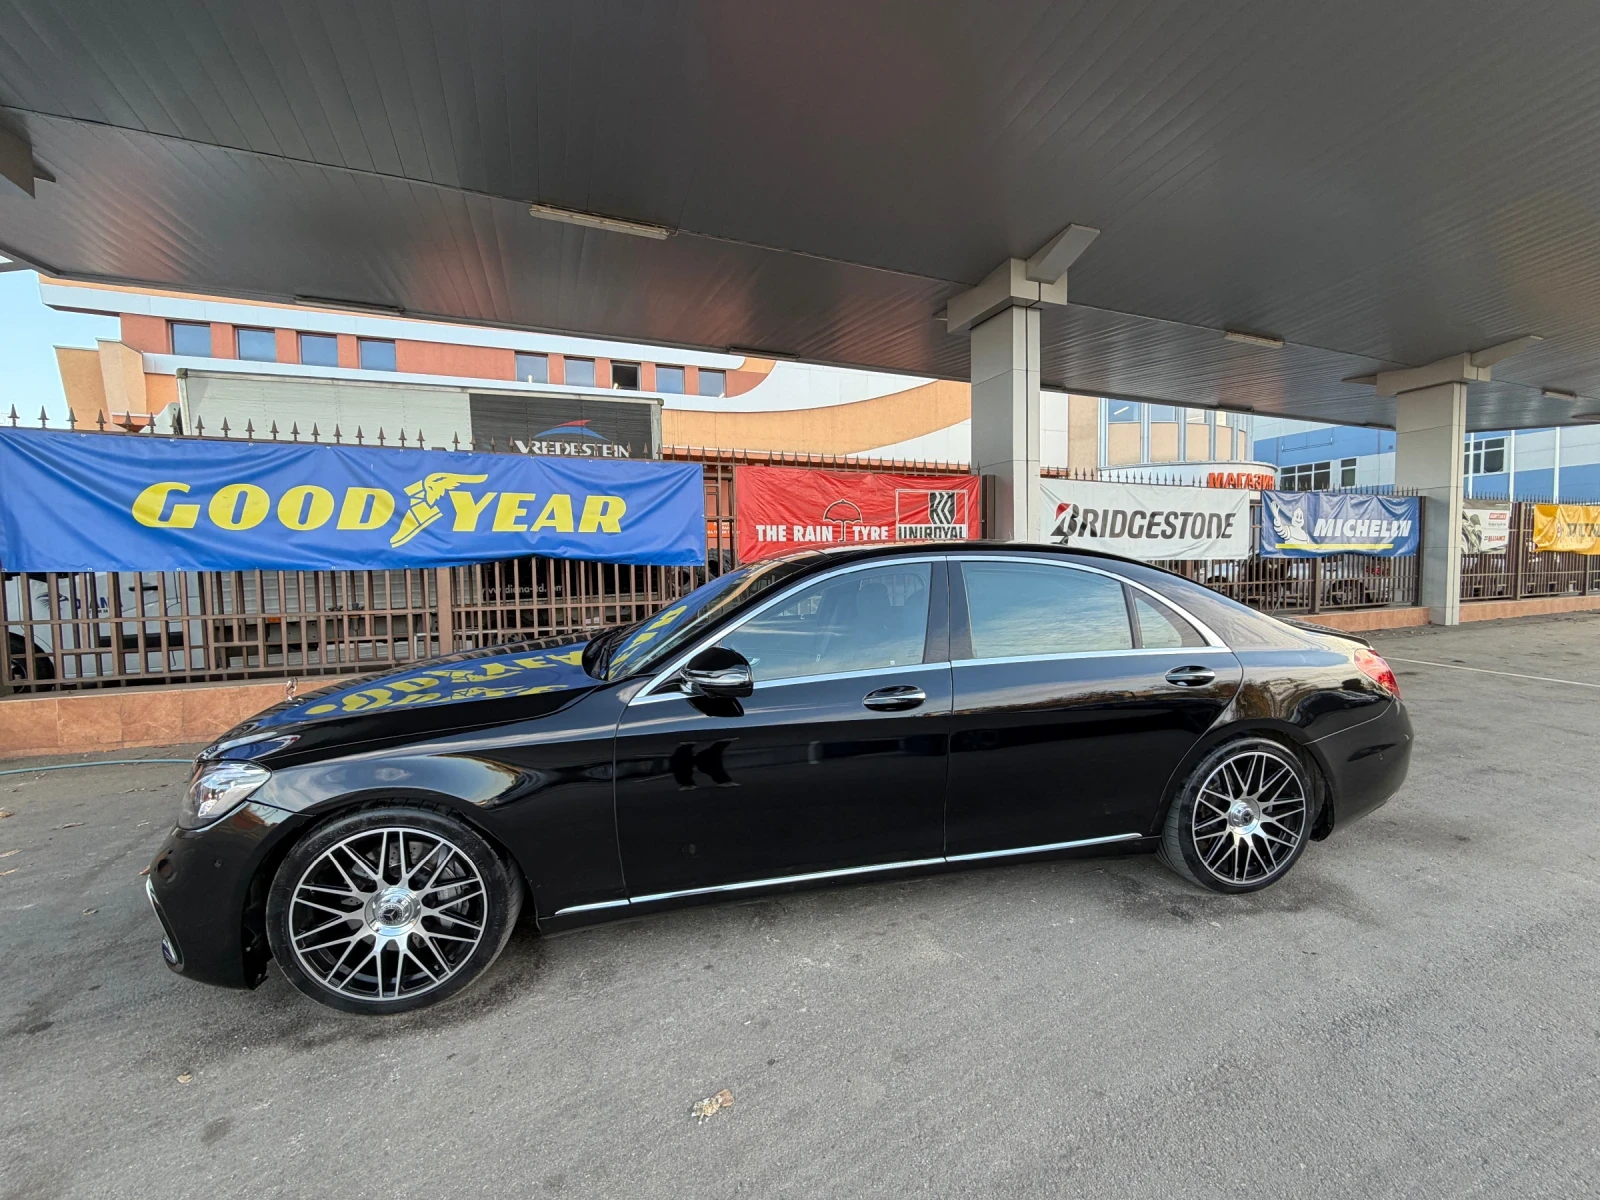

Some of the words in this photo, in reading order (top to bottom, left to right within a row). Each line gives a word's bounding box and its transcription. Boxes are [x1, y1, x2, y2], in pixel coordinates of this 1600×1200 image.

[514, 440, 630, 457] VREDESTEIN
[1208, 472, 1275, 489] МАГАЗИН
[1050, 502, 1237, 540] BRIDGESTONE
[1313, 518, 1412, 537] MICHELIN
[755, 524, 787, 542] THE
[793, 525, 833, 542] RAIN
[852, 525, 889, 541] TYRE
[898, 526, 966, 539] UNIROYAL
